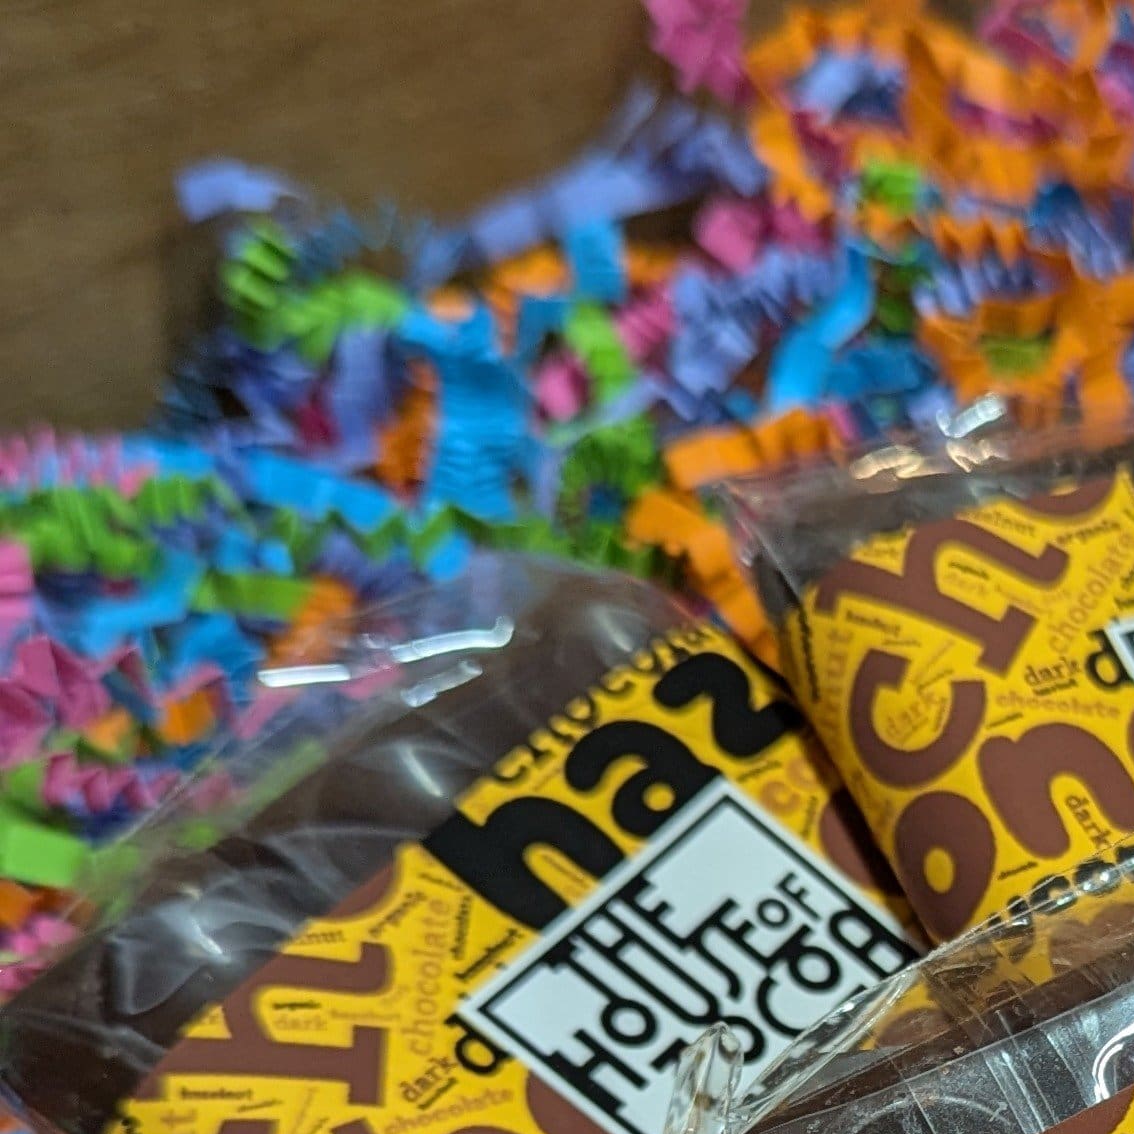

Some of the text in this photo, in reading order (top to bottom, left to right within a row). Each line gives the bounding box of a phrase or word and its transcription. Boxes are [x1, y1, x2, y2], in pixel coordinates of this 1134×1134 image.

[1024, 656, 1081, 686] dark
[996, 693, 1121, 721] chocolate
[1066, 794, 1112, 848] dark
[541, 876, 676, 1003] THE
[403, 899, 454, 1056] chocolate
[550, 872, 820, 1111] HOUSE OF
[399, 1056, 456, 1105] dark
